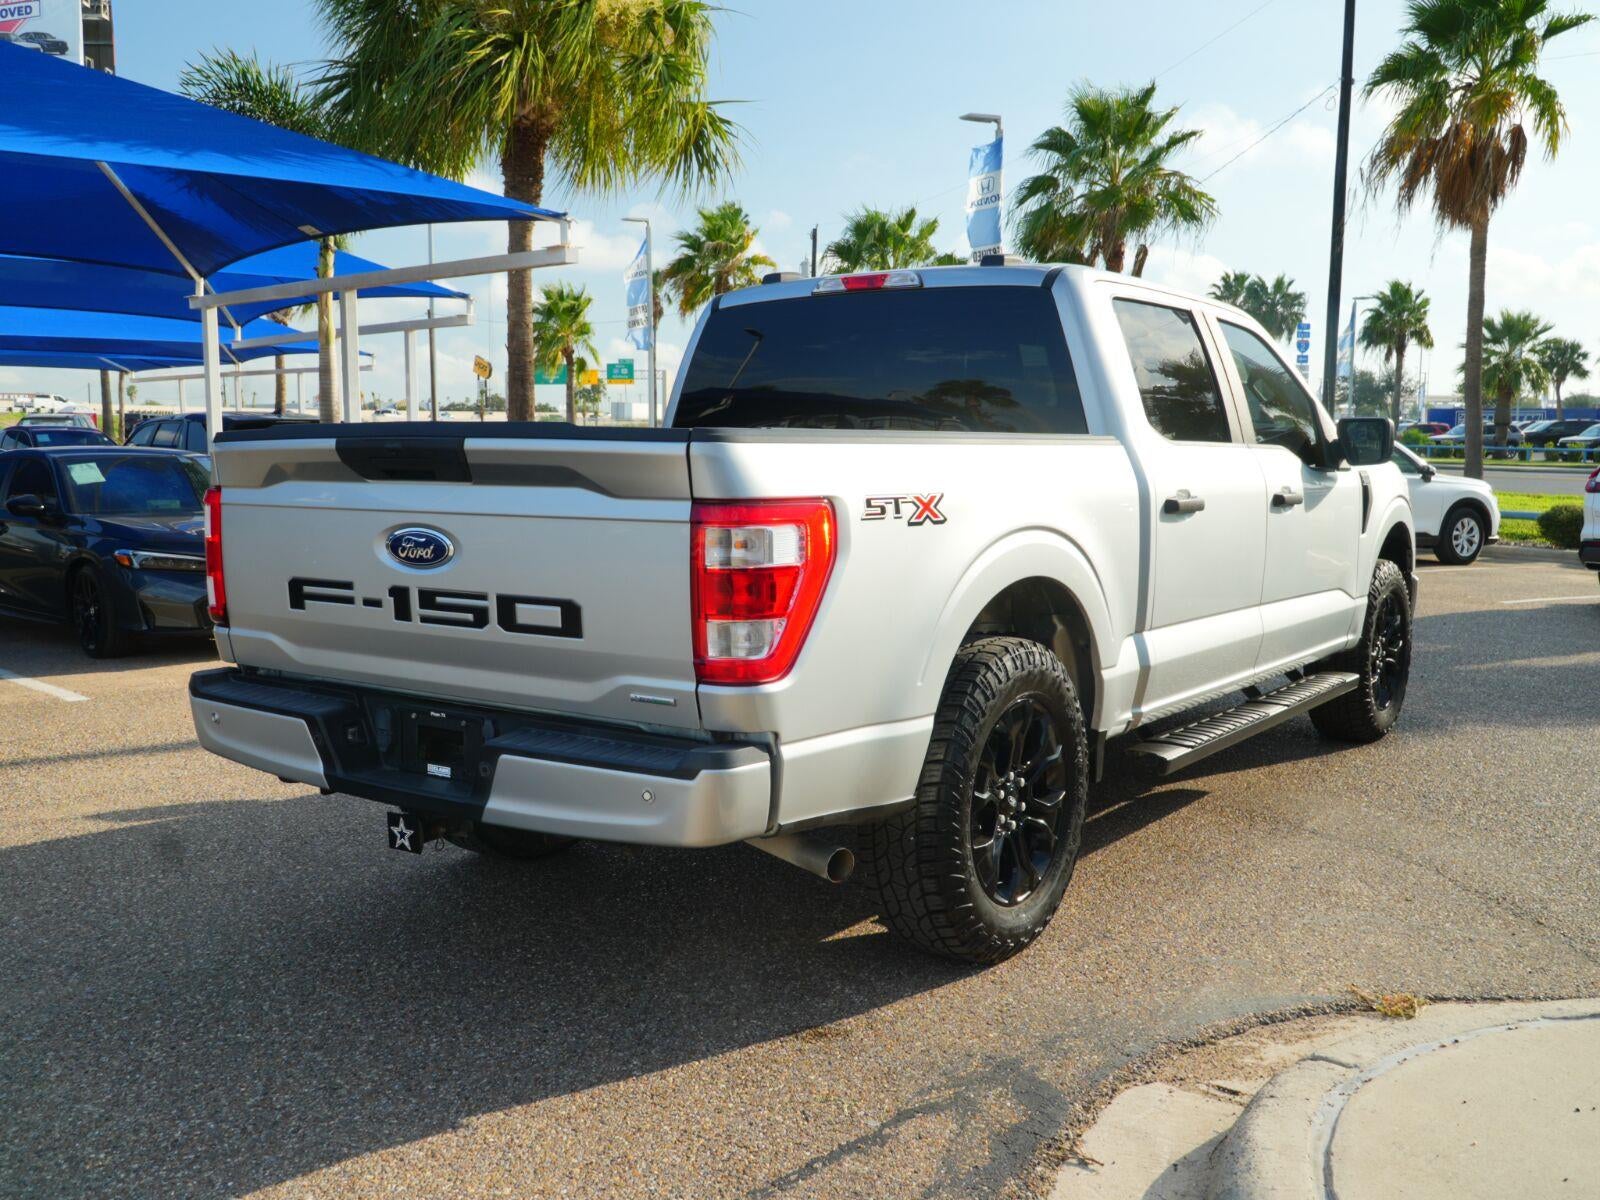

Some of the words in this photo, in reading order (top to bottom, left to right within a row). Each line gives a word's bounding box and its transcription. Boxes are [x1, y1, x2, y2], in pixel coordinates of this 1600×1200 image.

[860, 493, 948, 526] STX
[398, 536, 435, 559] Ford
[288, 577, 583, 638] F-150
